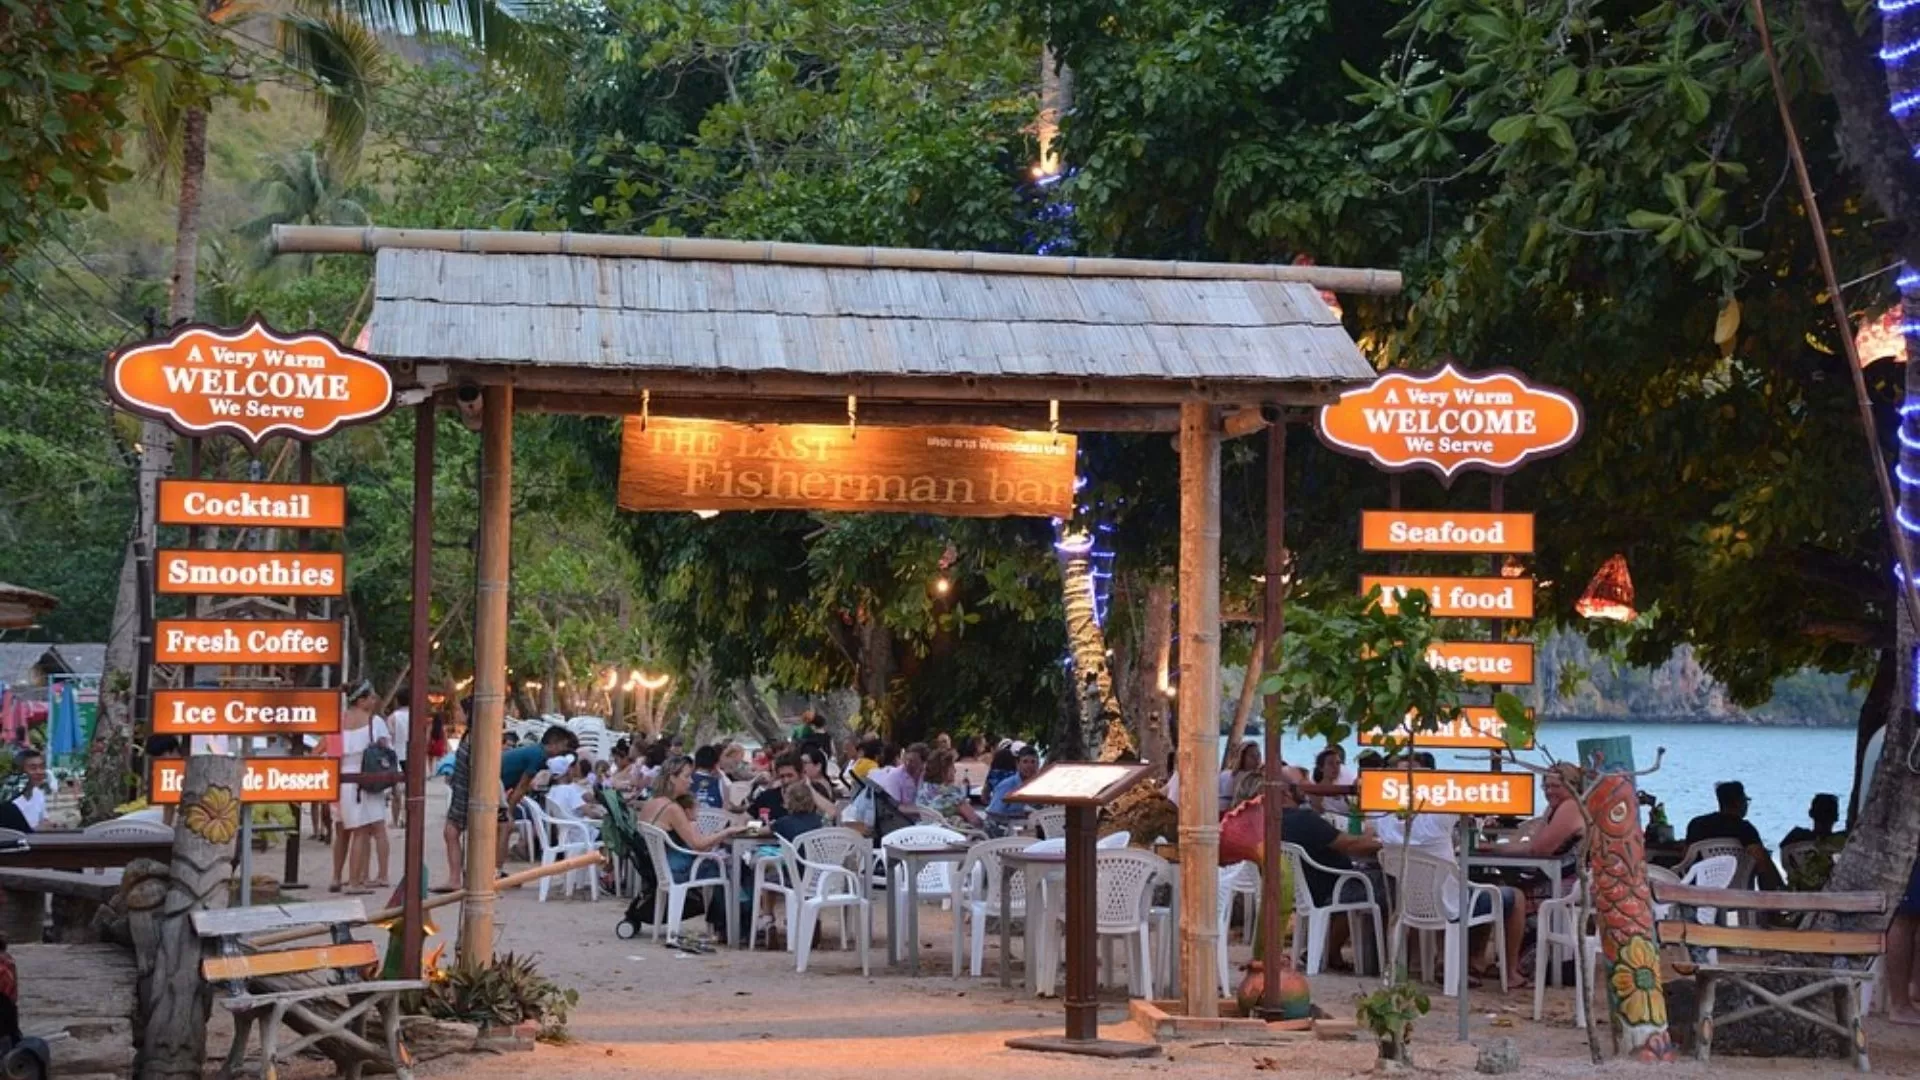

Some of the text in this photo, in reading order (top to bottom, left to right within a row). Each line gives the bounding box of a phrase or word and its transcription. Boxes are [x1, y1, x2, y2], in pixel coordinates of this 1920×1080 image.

[187, 345, 326, 369] A Very Warm
[162, 366, 349, 400] WELCOME
[209, 398, 304, 418] We Serve
[1384, 388, 1513, 407] A Very Warm
[1362, 409, 1537, 434] WELCOME
[650, 429, 836, 461] THE LAST
[1405, 437, 1493, 453] We Serve
[681, 458, 1069, 506] Fisherman bar
[183, 492, 311, 518] Cocktail
[1389, 522, 1504, 544] Seafood
[168, 560, 334, 586] Smoothies
[1449, 586, 1514, 609] food
[166, 629, 329, 653] Fresh Coffee
[172, 701, 317, 724] Ice Cream
[267, 768, 330, 791] Dessert
[1382, 778, 1511, 807] Spaghetti
